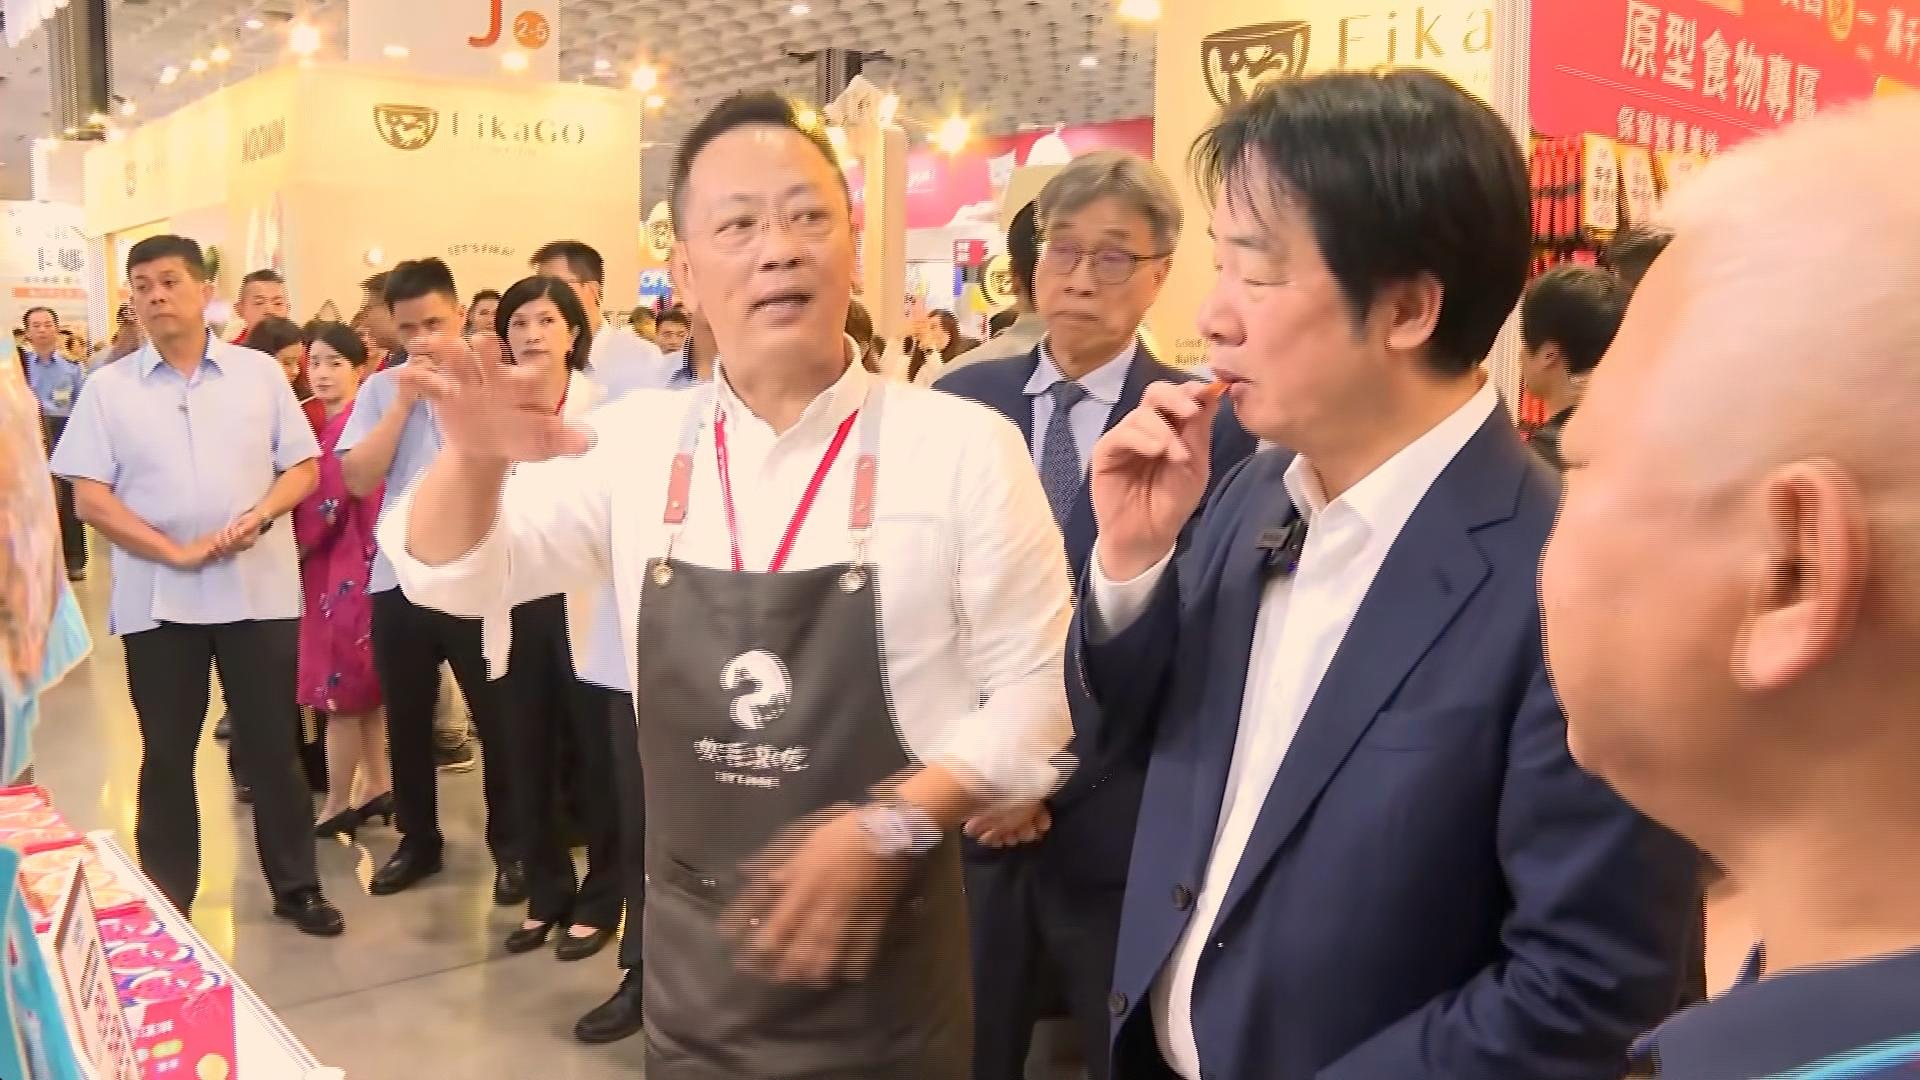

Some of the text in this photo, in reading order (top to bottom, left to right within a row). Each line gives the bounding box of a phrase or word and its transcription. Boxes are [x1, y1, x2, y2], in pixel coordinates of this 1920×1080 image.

[1338, 8, 1493, 68] Fika
[1620, 1, 1821, 123] 原型食物專區
